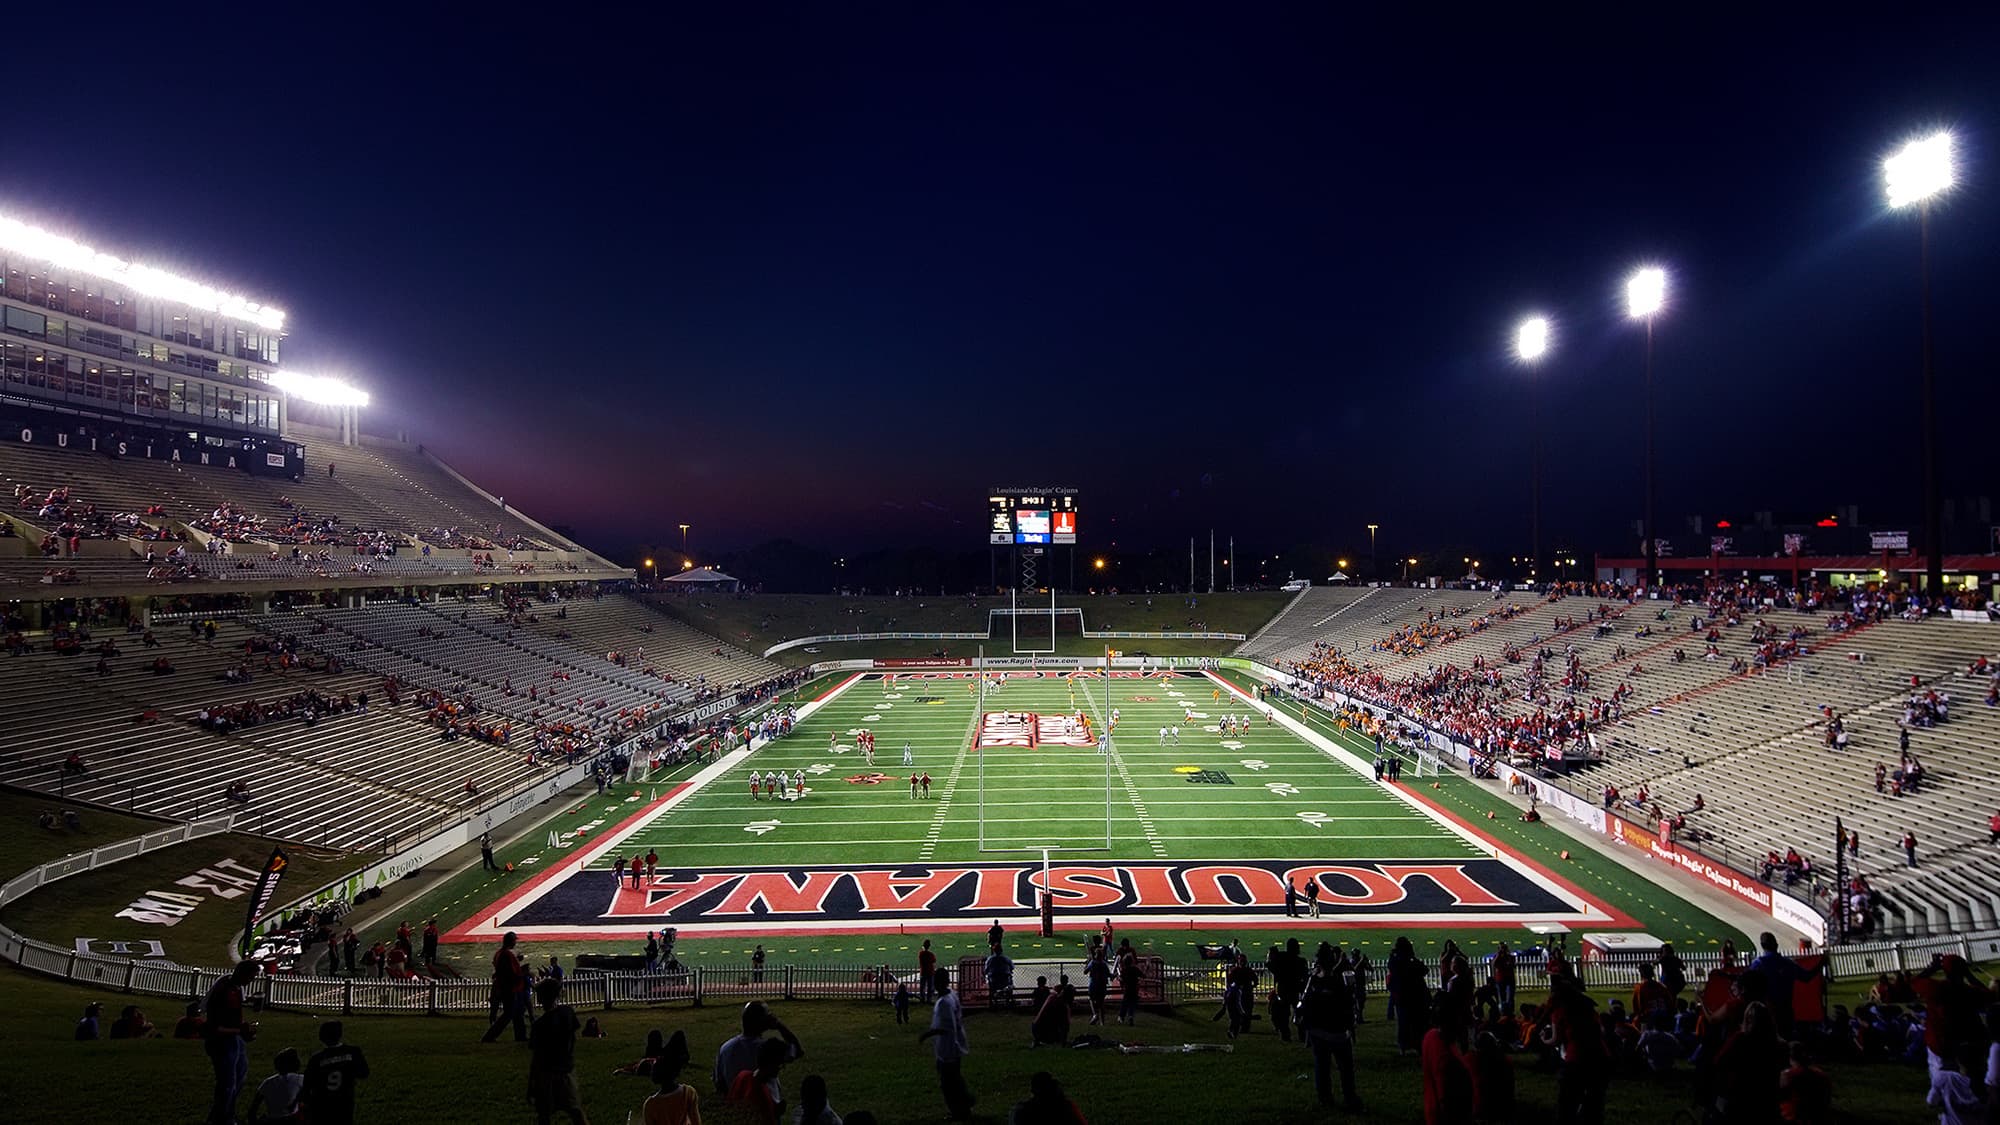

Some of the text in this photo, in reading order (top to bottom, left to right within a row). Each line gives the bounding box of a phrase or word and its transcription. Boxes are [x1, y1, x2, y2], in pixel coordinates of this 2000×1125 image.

[1055, 487, 1078, 495] Cajuns
[1705, 866, 1731, 887] Cajuns
[599, 864, 1520, 917] LOUISIANA
[325, 1070, 342, 1091] 9
